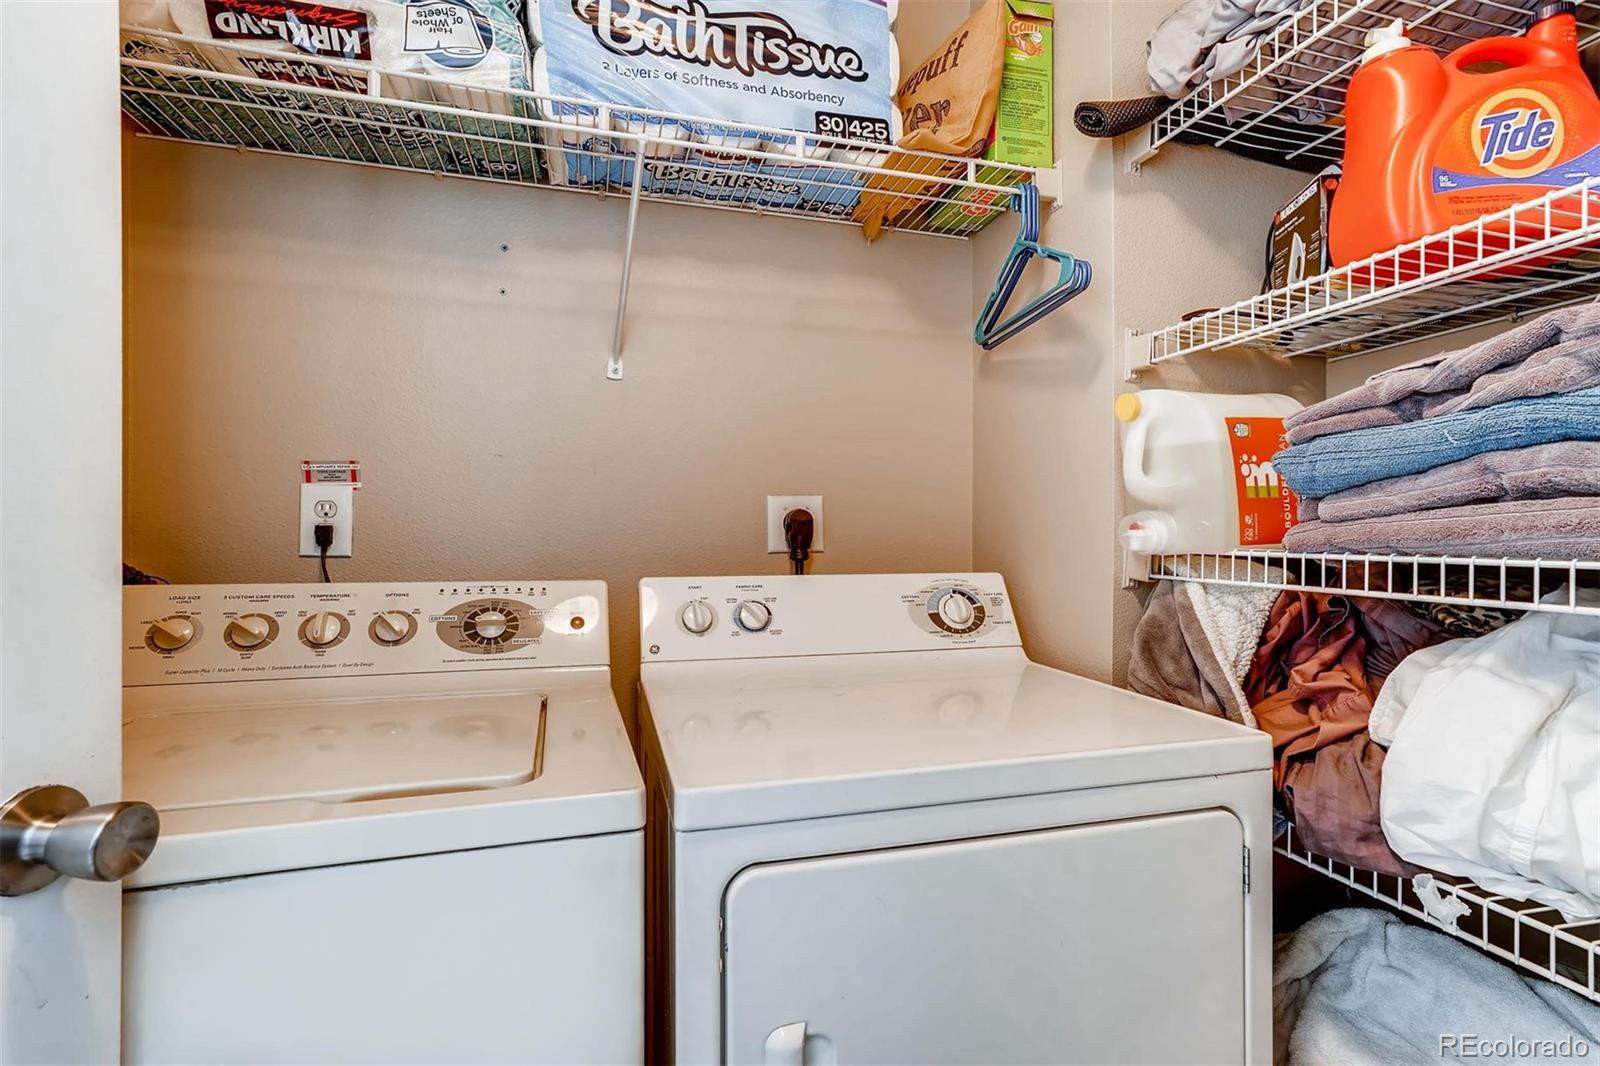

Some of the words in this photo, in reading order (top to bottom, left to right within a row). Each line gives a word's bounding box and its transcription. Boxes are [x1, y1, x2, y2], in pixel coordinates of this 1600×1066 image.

[411, 18, 449, 27] Whole
[416, 6, 457, 18] Sheets
[452, 16, 464, 25] or
[215, 11, 362, 54] KIRKLAND
[1008, 18, 1040, 37] Gain
[602, 61, 611, 70] 2
[615, 64, 661, 80] Layers
[664, 71, 679, 81] of
[682, 72, 740, 90] Softness
[742, 83, 767, 94] and
[770, 86, 846, 107] Absorbency
[819, 115, 844, 133] 30
[849, 120, 888, 140] 425
[1479, 110, 1557, 166] Tide
